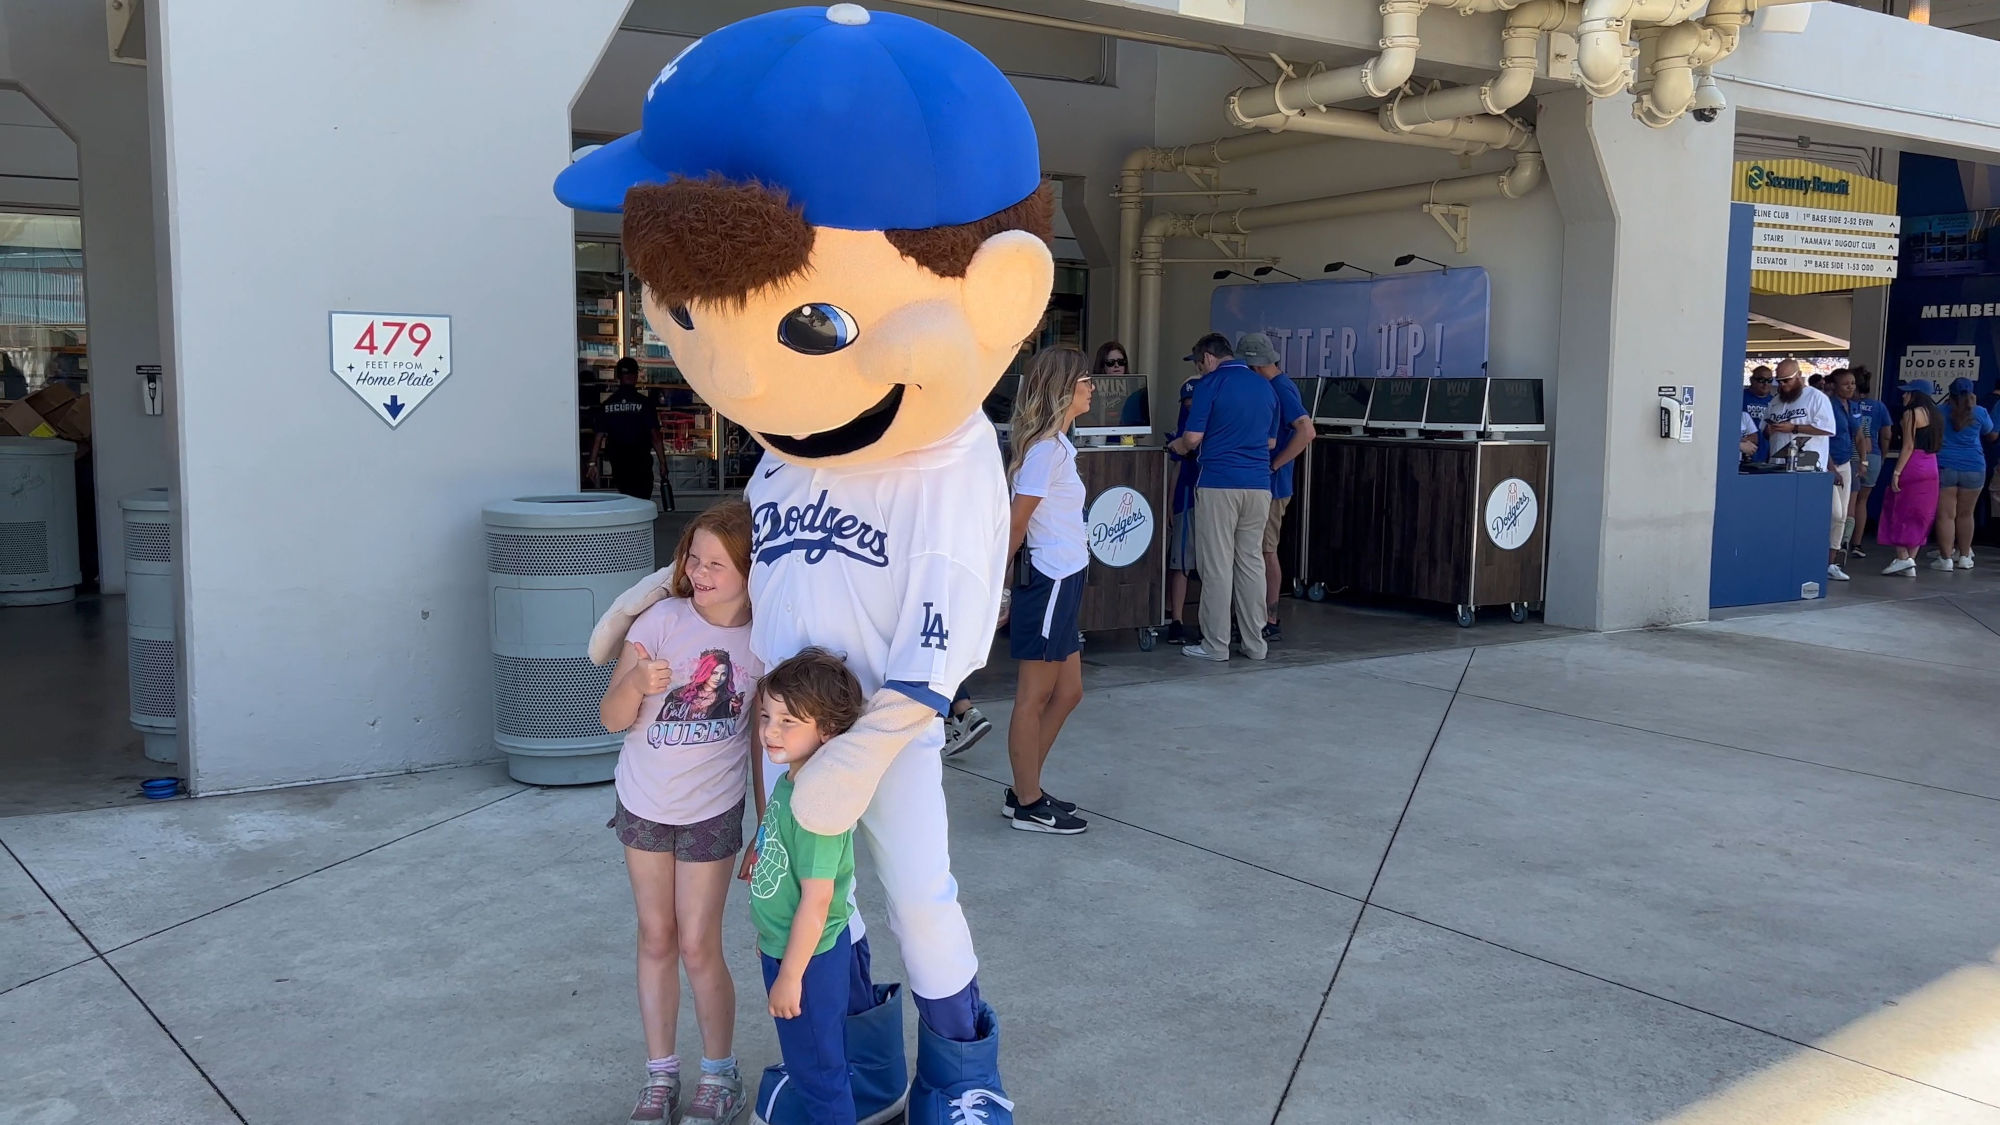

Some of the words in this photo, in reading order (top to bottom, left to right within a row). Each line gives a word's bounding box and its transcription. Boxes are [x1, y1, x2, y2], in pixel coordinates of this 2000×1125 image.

[1765, 170, 1812, 195] Security
[1812, 176, 1850, 196] Benefit
[1773, 210, 1790, 220] CLUB
[1811, 214, 1828, 224] BASE
[1828, 216, 1842, 224] SIDE
[1843, 217, 1858, 226] 2-52
[1858, 218, 1874, 227] EVEN
[1763, 233, 1784, 243] STAIRS
[1834, 239, 1860, 249] DUGOUT
[1861, 241, 1876, 250] CLUB
[1756, 256, 1788, 266] ELEVATOR
[1814, 260, 1830, 269] BASE
[1830, 261, 1844, 269] SIDE
[1847, 262, 1860, 271] 1-53
[353, 320, 432, 357] 479
[365, 361, 389, 369] FEET
[1905, 359, 1975, 368] DODGERS
[355, 371, 397, 386] Home
[396, 371, 435, 387] Plate
[1904, 369, 1975, 378] MEMBERSHIP
[1095, 378, 1128, 393] WIN
[604, 403, 643, 413] SECURITY
[1491, 491, 1530, 539] Dodgers
[751, 489, 889, 568] Dodgers
[1092, 507, 1146, 547] Dodgers
[920, 601, 949, 651] LA
[661, 700, 691, 721] Call
[692, 711, 708, 720] me
[646, 717, 740, 750] QUEEN
